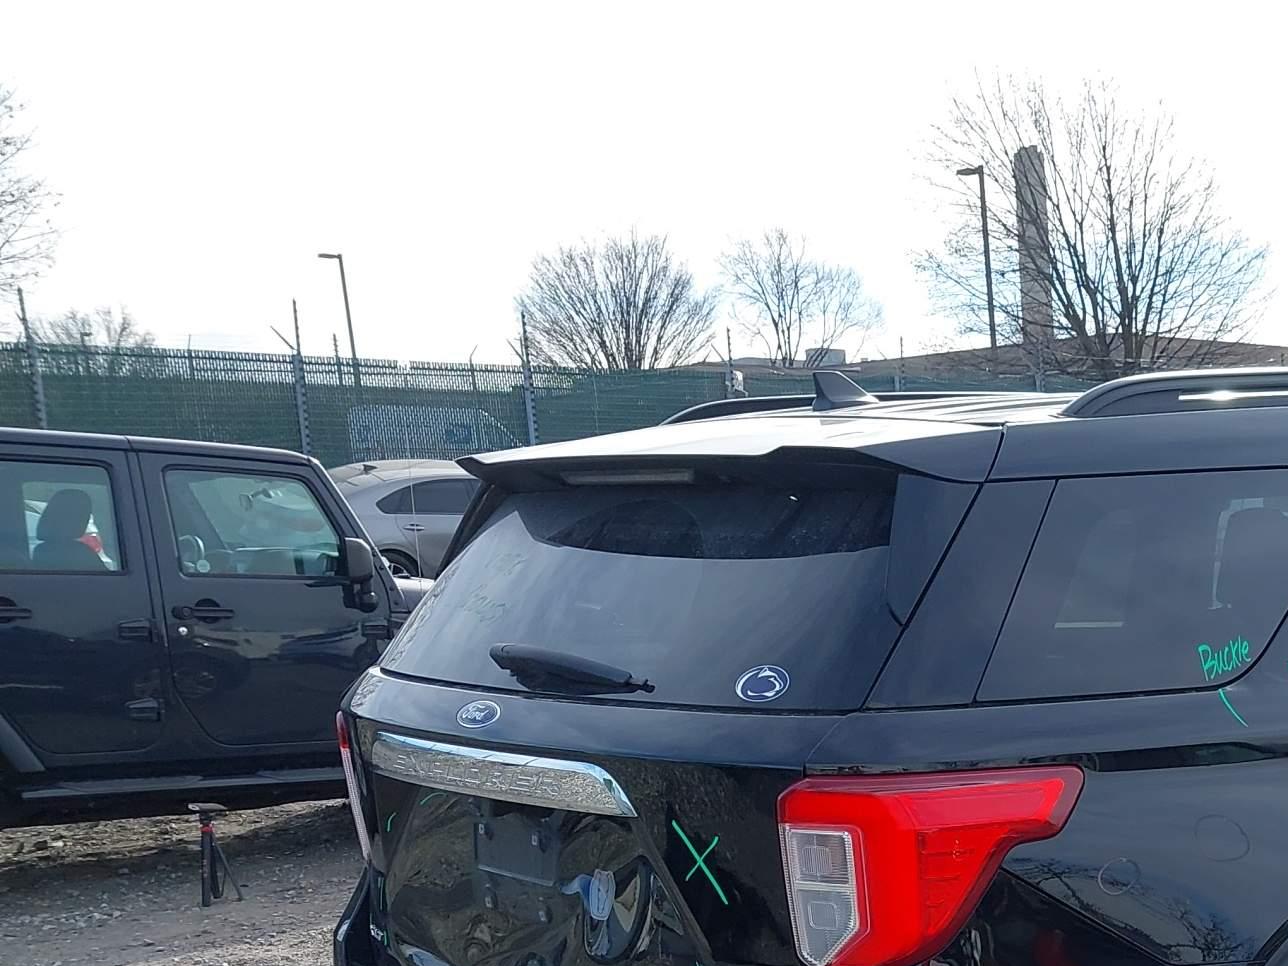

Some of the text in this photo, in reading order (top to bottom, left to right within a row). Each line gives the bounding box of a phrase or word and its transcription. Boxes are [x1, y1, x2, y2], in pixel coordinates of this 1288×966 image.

[1197, 635, 1252, 682] Buckle
[462, 704, 490, 722] Ford
[393, 754, 562, 796] EXPLORER
